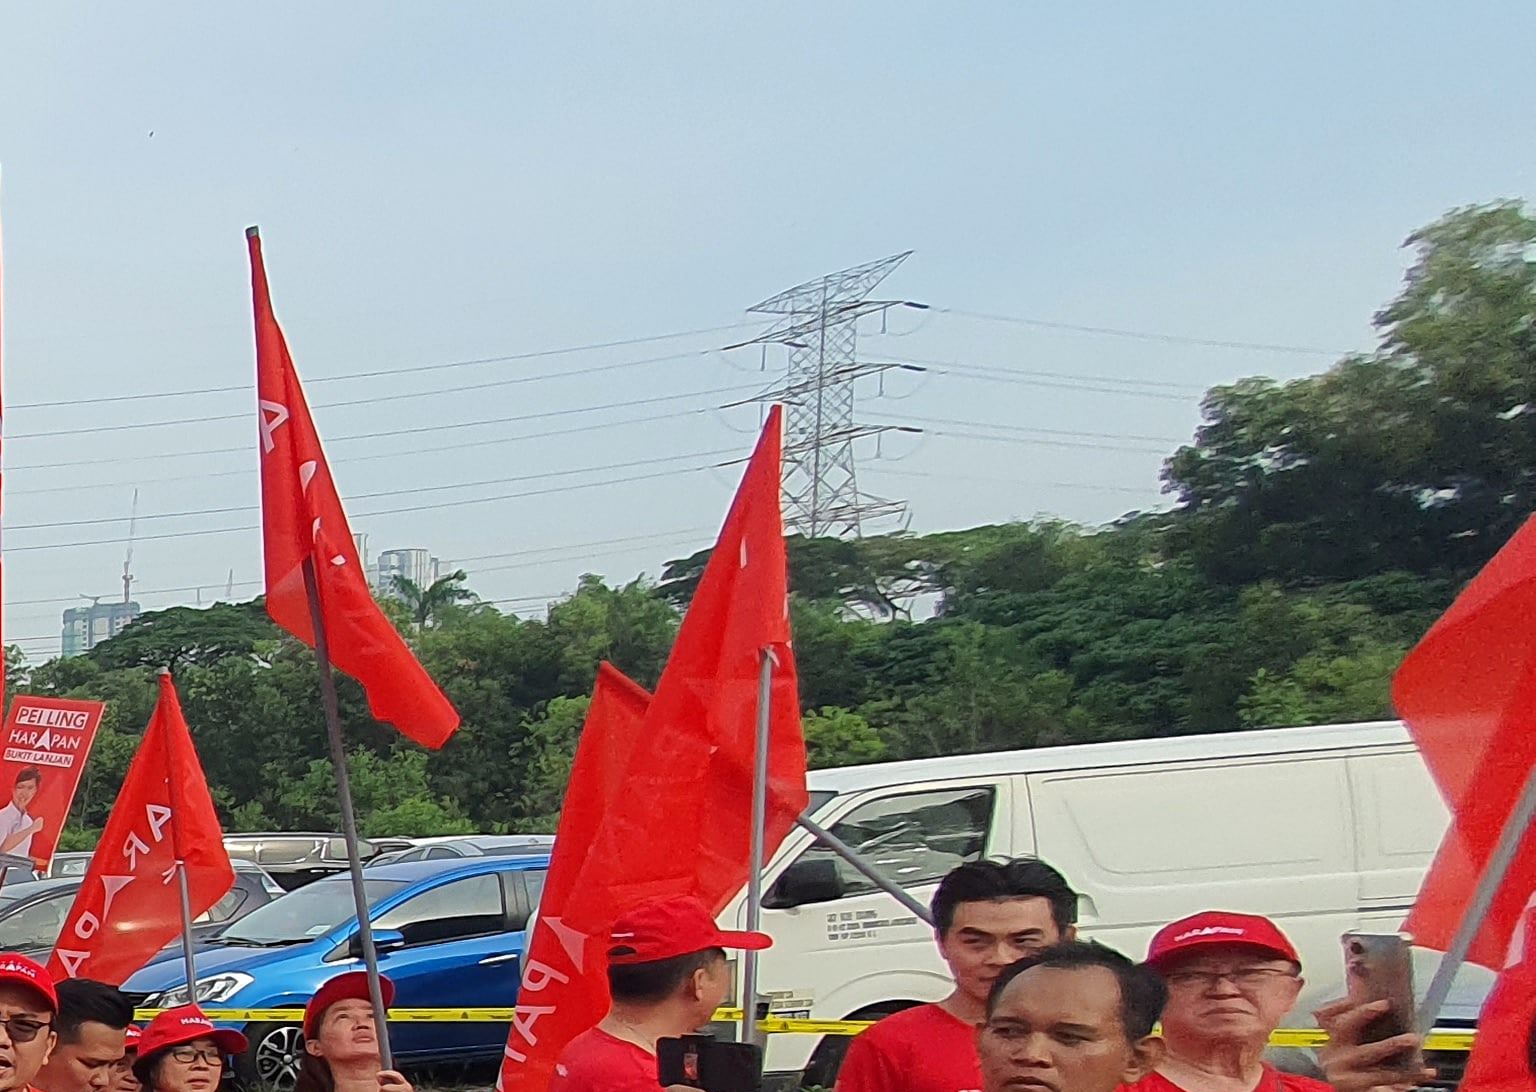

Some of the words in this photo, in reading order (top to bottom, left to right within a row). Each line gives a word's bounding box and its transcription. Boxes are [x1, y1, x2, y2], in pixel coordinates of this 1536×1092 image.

[17, 709, 44, 724] PEI
[46, 711, 86, 728] LING
[8, 728, 81, 751] HARAPAN
